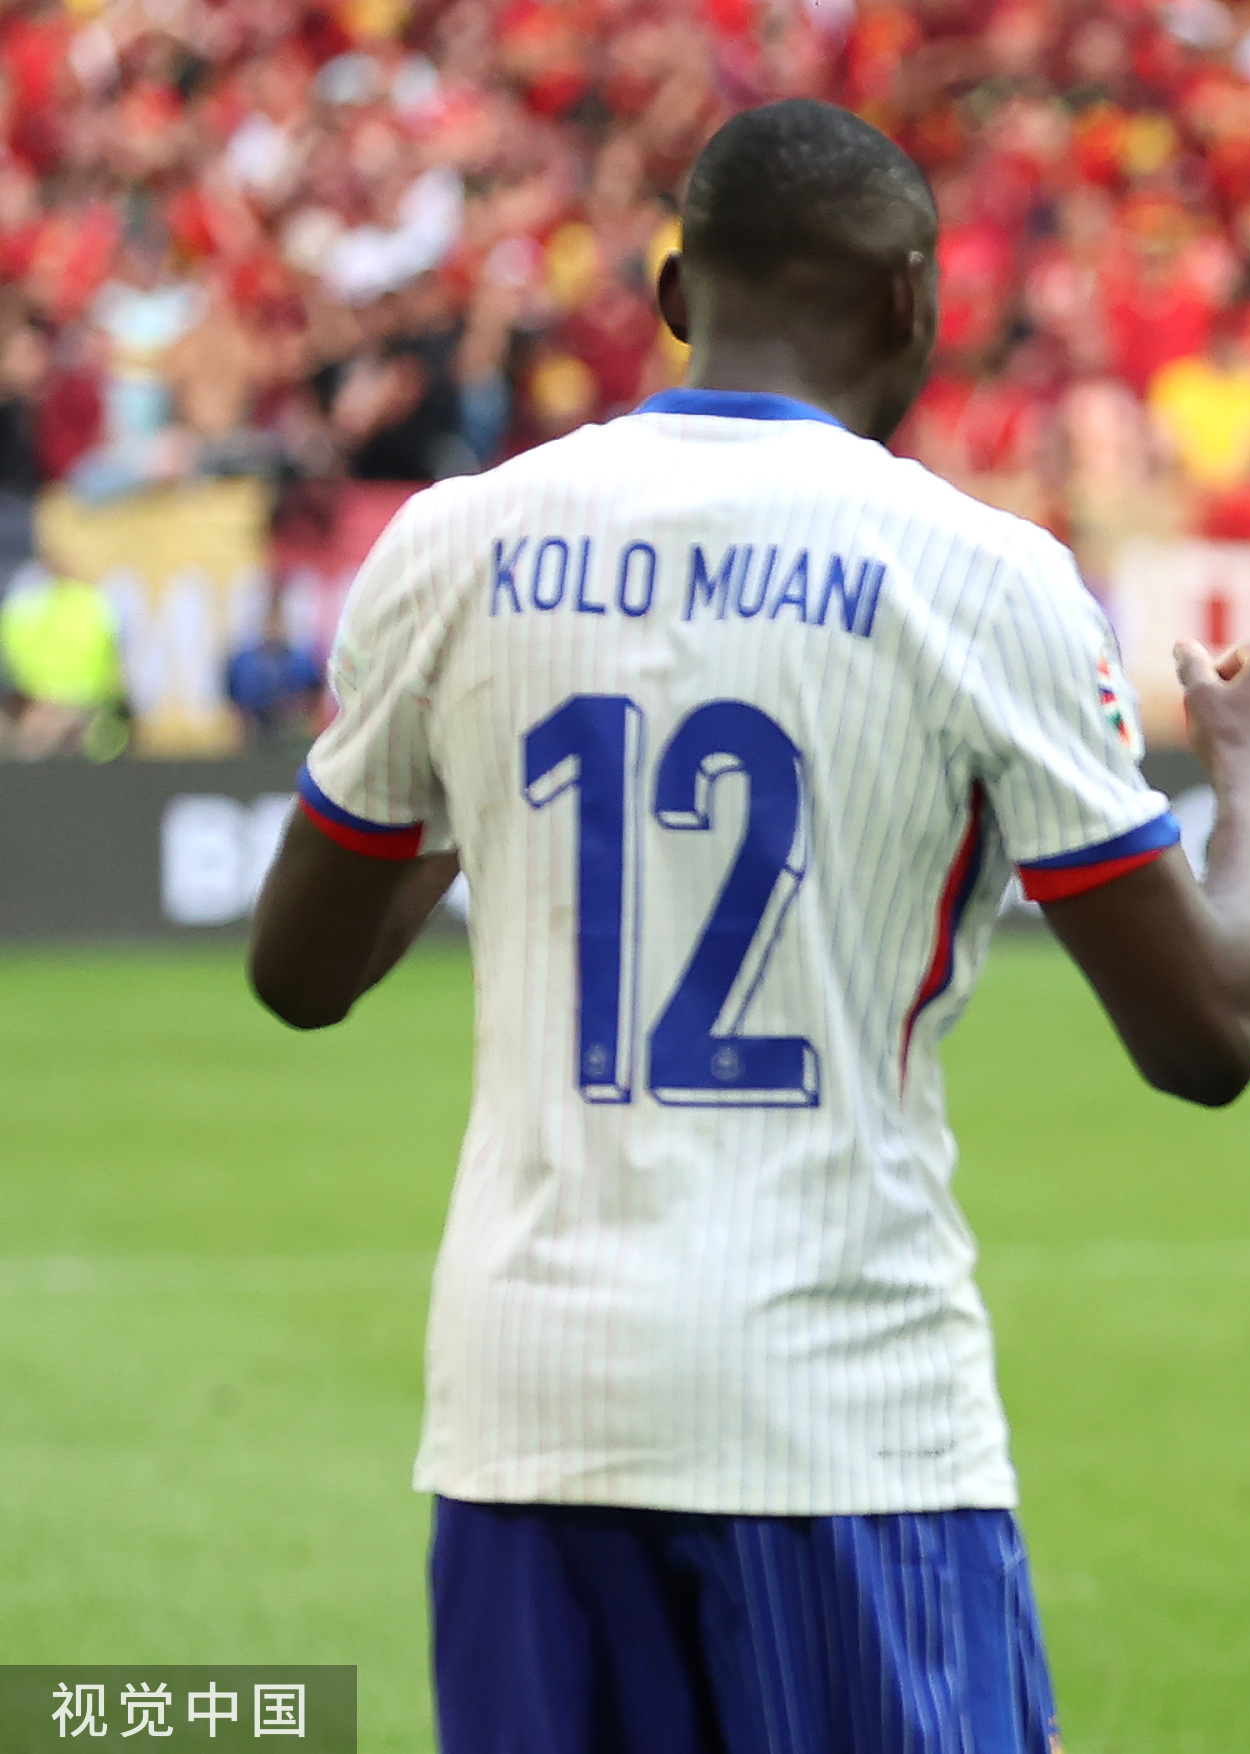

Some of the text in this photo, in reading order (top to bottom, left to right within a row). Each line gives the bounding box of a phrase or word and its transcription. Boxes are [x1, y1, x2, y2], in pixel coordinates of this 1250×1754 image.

[490, 535, 887, 638] KOLO MUANI
[520, 693, 820, 1108] 12
